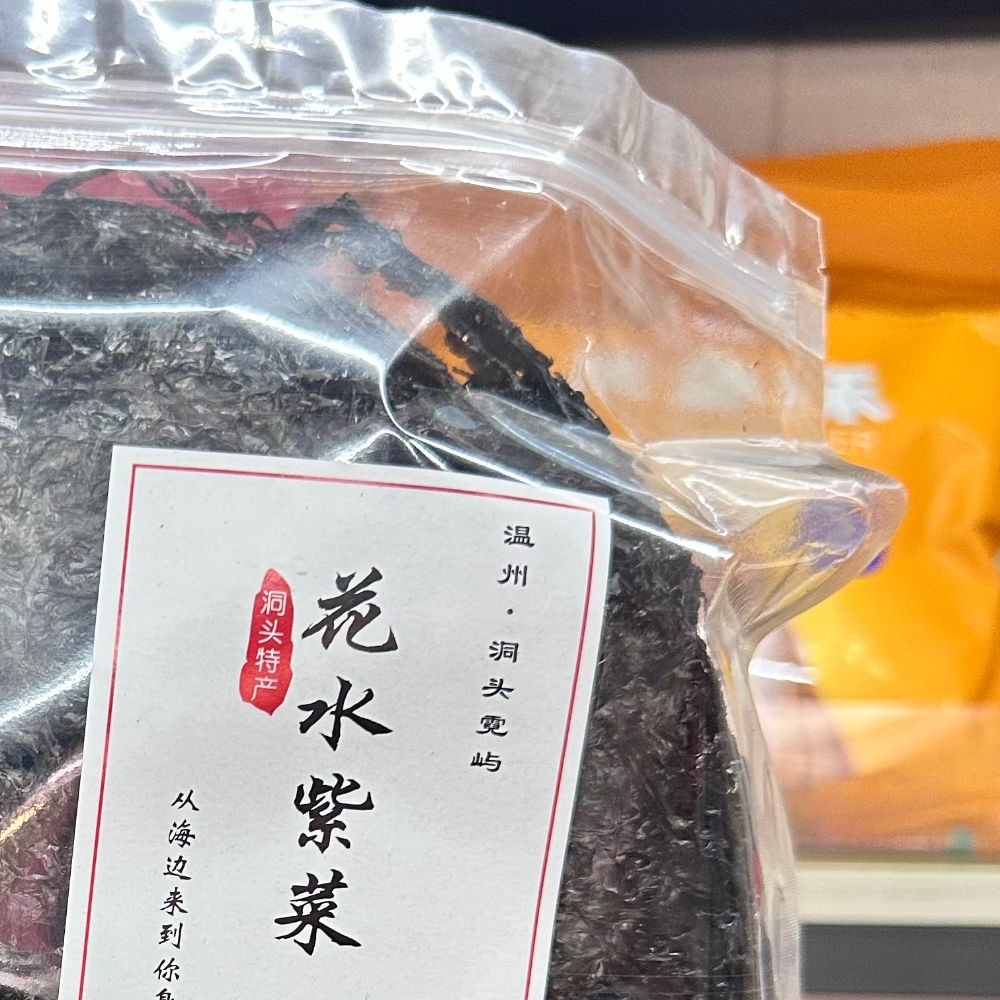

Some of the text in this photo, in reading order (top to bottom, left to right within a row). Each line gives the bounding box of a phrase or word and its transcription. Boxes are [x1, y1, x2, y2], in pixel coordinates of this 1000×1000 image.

[250, 589, 287, 702] 洞头特产
[273, 566, 399, 956] 花水紫菜
